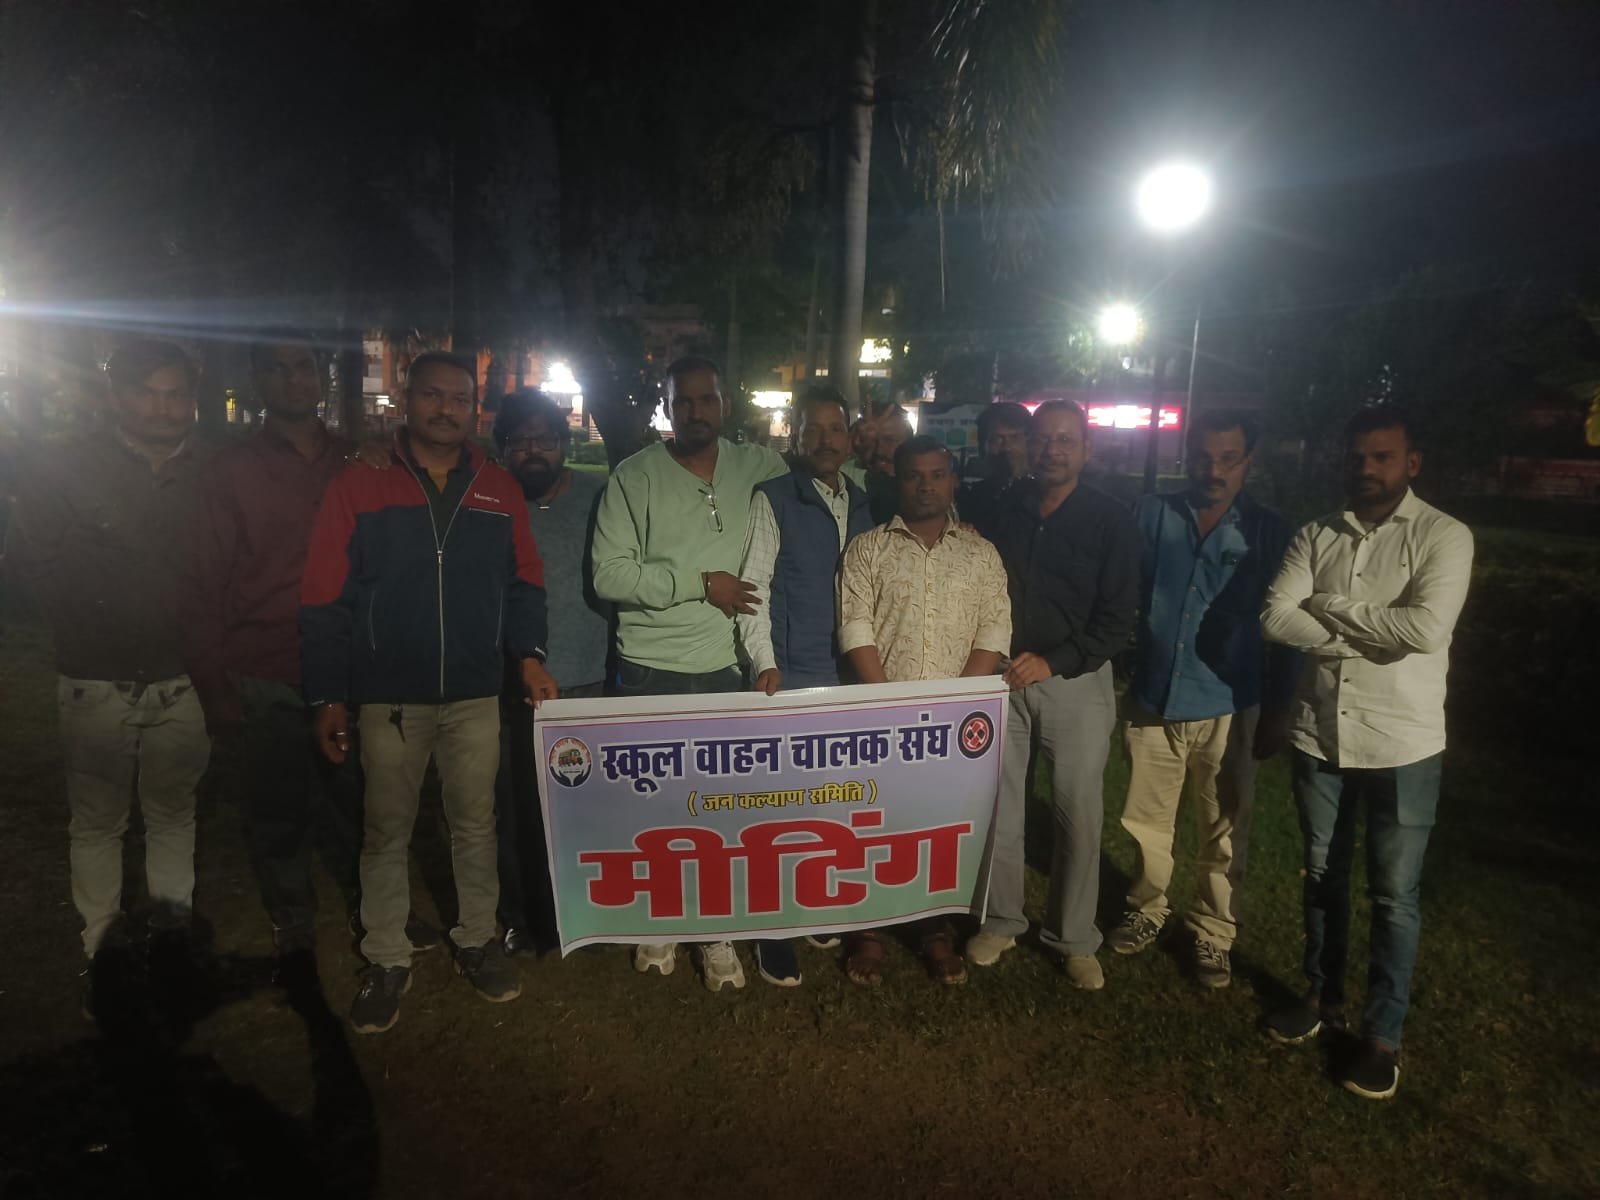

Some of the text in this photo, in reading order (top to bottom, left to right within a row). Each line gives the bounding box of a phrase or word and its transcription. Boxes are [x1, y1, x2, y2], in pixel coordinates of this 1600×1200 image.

[601, 742, 685, 792] स्कूल
[694, 738, 782, 775] वाहन
[790, 729, 891, 769] चालक
[898, 713, 952, 762] संघ
[738, 790, 805, 808] कल्याण
[580, 811, 971, 918] मीटिंग
